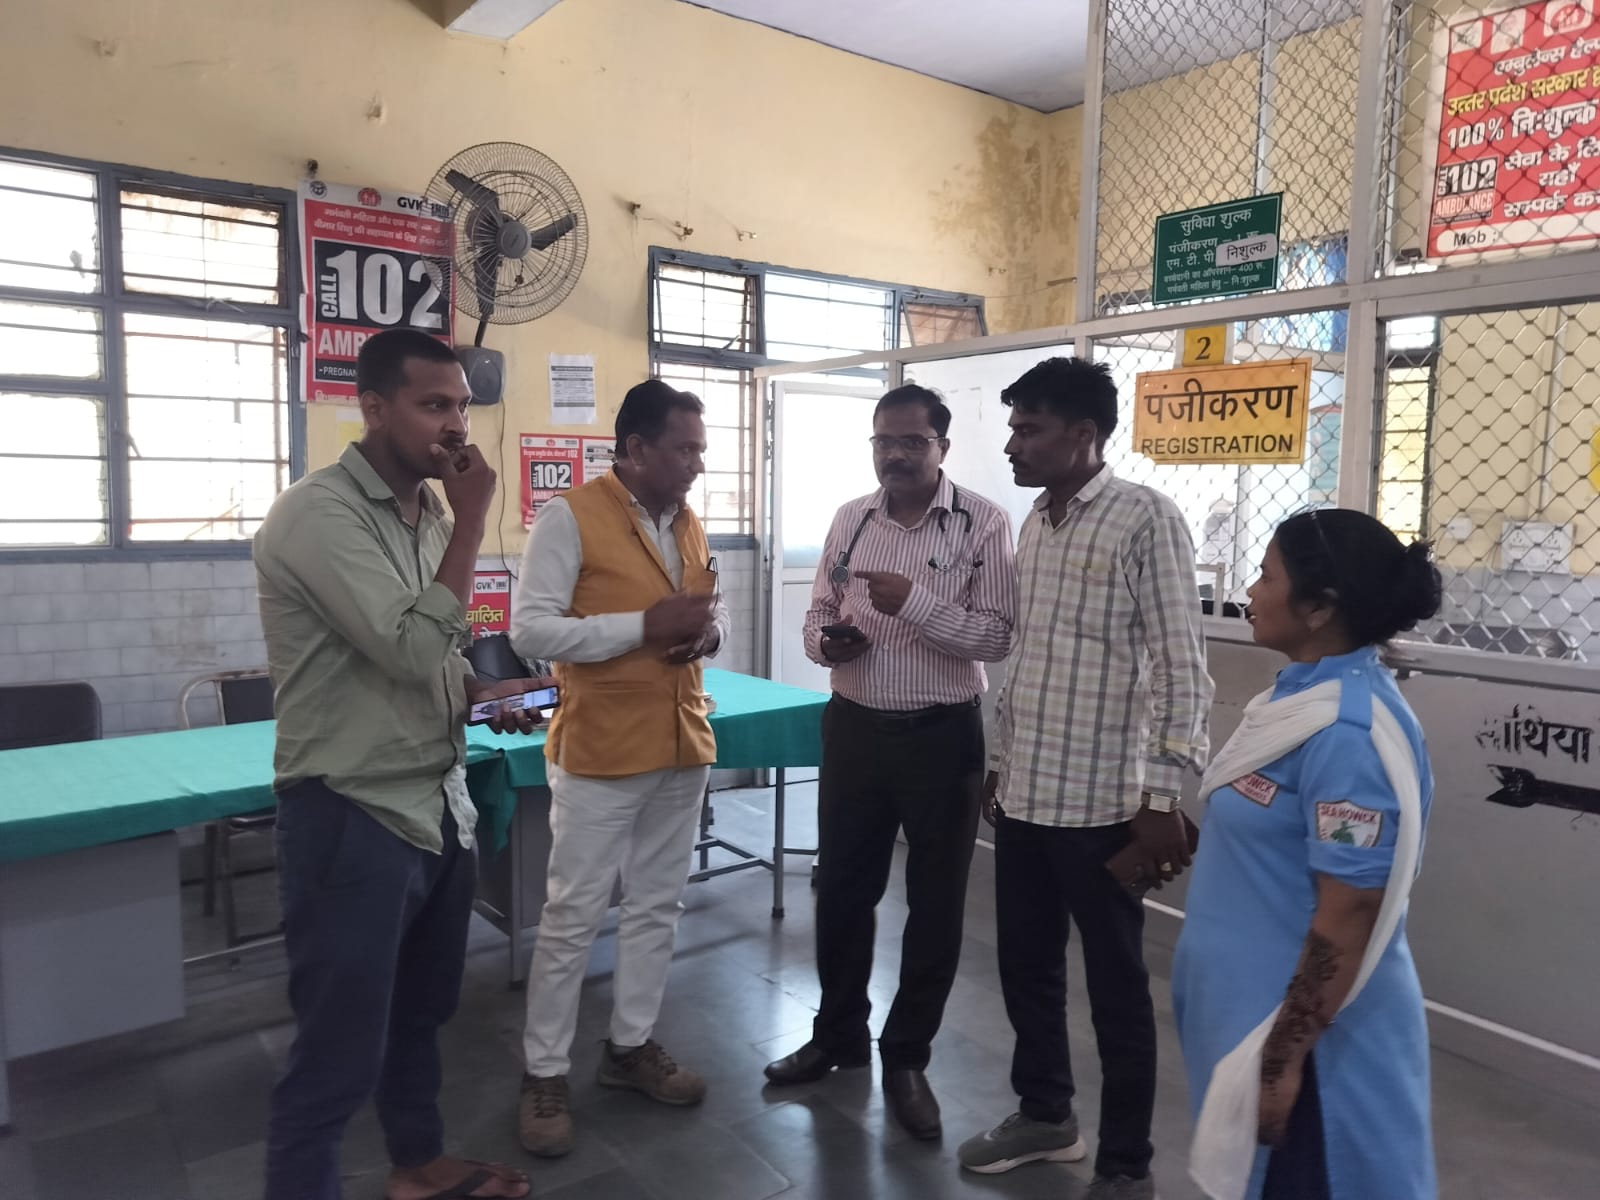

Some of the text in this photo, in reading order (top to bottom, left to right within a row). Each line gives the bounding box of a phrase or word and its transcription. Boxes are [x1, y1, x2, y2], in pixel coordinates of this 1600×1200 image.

[1447, 94, 1487, 117] उत्तर
[1487, 78, 1528, 107] प्रदेश
[1531, 68, 1591, 99] सरकार
[1447, 117, 1505, 150] 100%
[1504, 149, 1544, 171] सेवा
[1548, 142, 1572, 162] के
[1447, 158, 1497, 194] 102
[1504, 189, 1569, 218] सम्पर्क
[1180, 215, 1217, 237] सुविधा
[1219, 208, 1253, 230] शुल्क
[1168, 237, 1218, 255] पंजीकरण
[1226, 240, 1268, 261] निशुल्क
[1238, 262, 1254, 272] 400
[320, 273, 339, 319] CALL
[325, 249, 444, 330] 102
[1195, 336, 1212, 361] 2
[1143, 378, 1299, 424] पंजीकरण
[1142, 434, 1294, 455] REGISTRATION
[534, 463, 572, 489] 102
[475, 582, 493, 591] GVK
